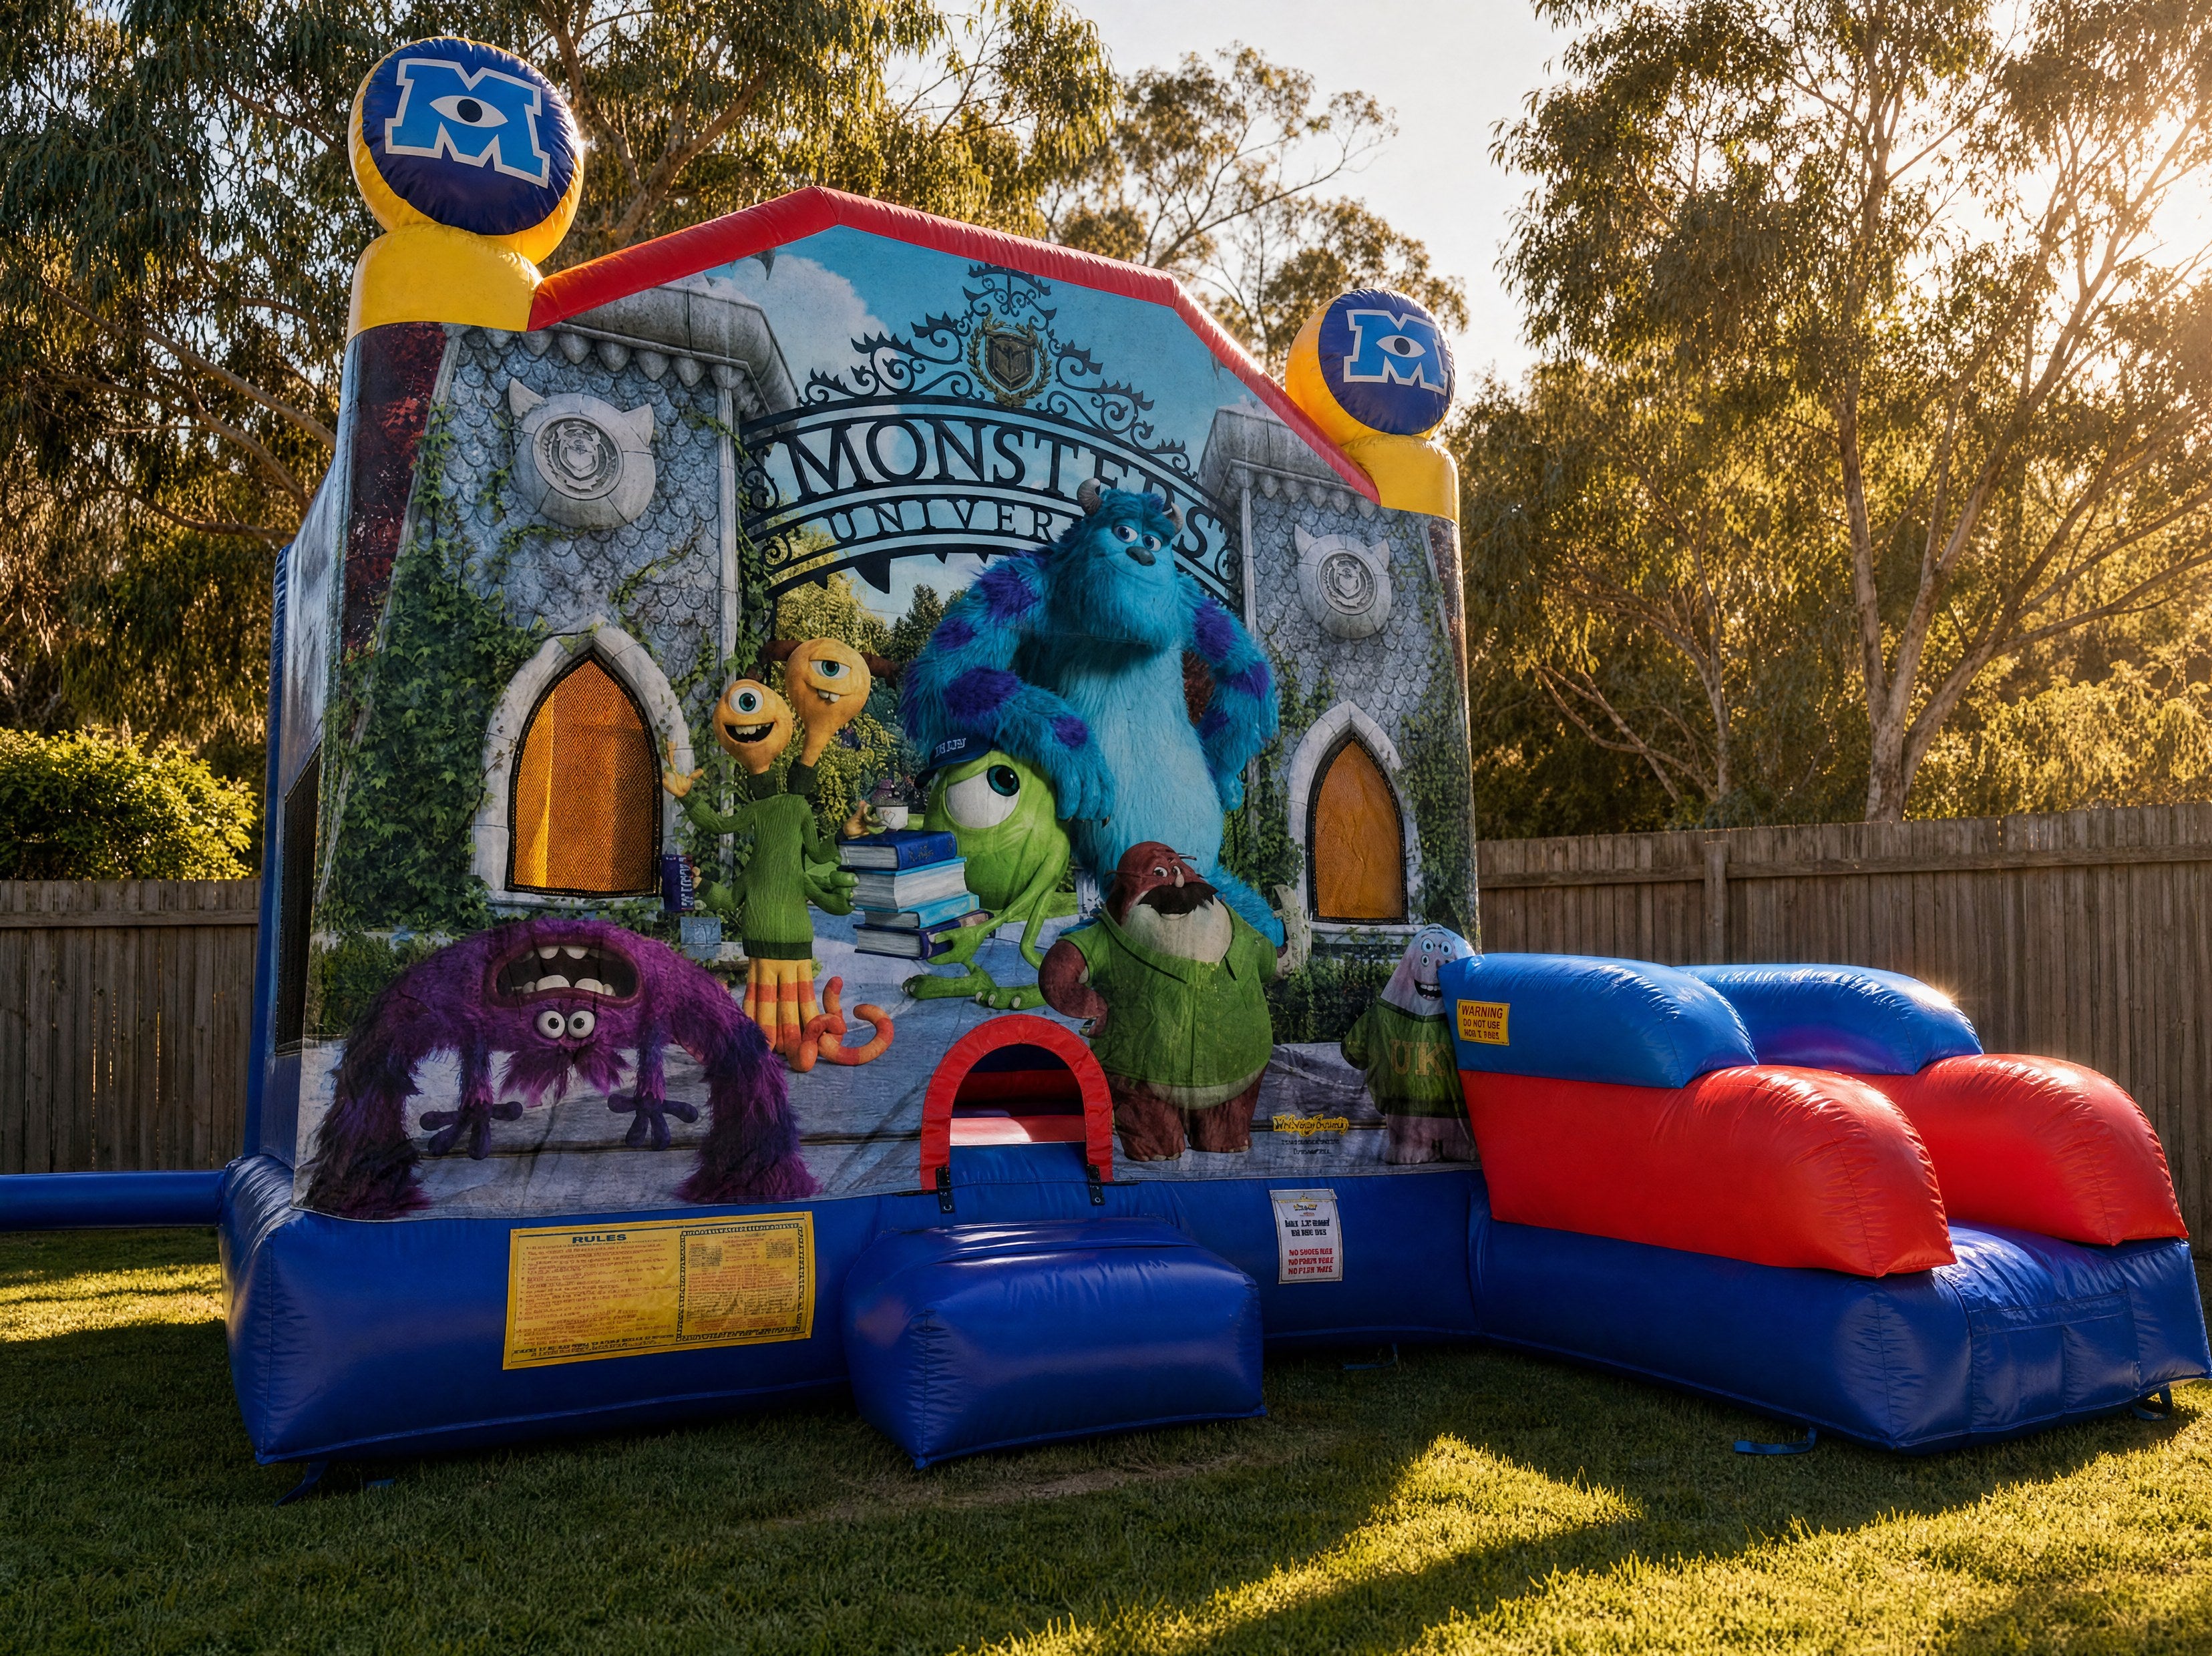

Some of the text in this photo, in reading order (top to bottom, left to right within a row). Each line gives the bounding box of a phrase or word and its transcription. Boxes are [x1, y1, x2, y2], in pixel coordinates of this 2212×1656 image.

[823, 497, 1069, 542] UNIVER
[1462, 1006, 1503, 1018] WARNING
[1463, 1018, 1500, 1029] DO NOT USE
[572, 1234, 626, 1243] RULES
